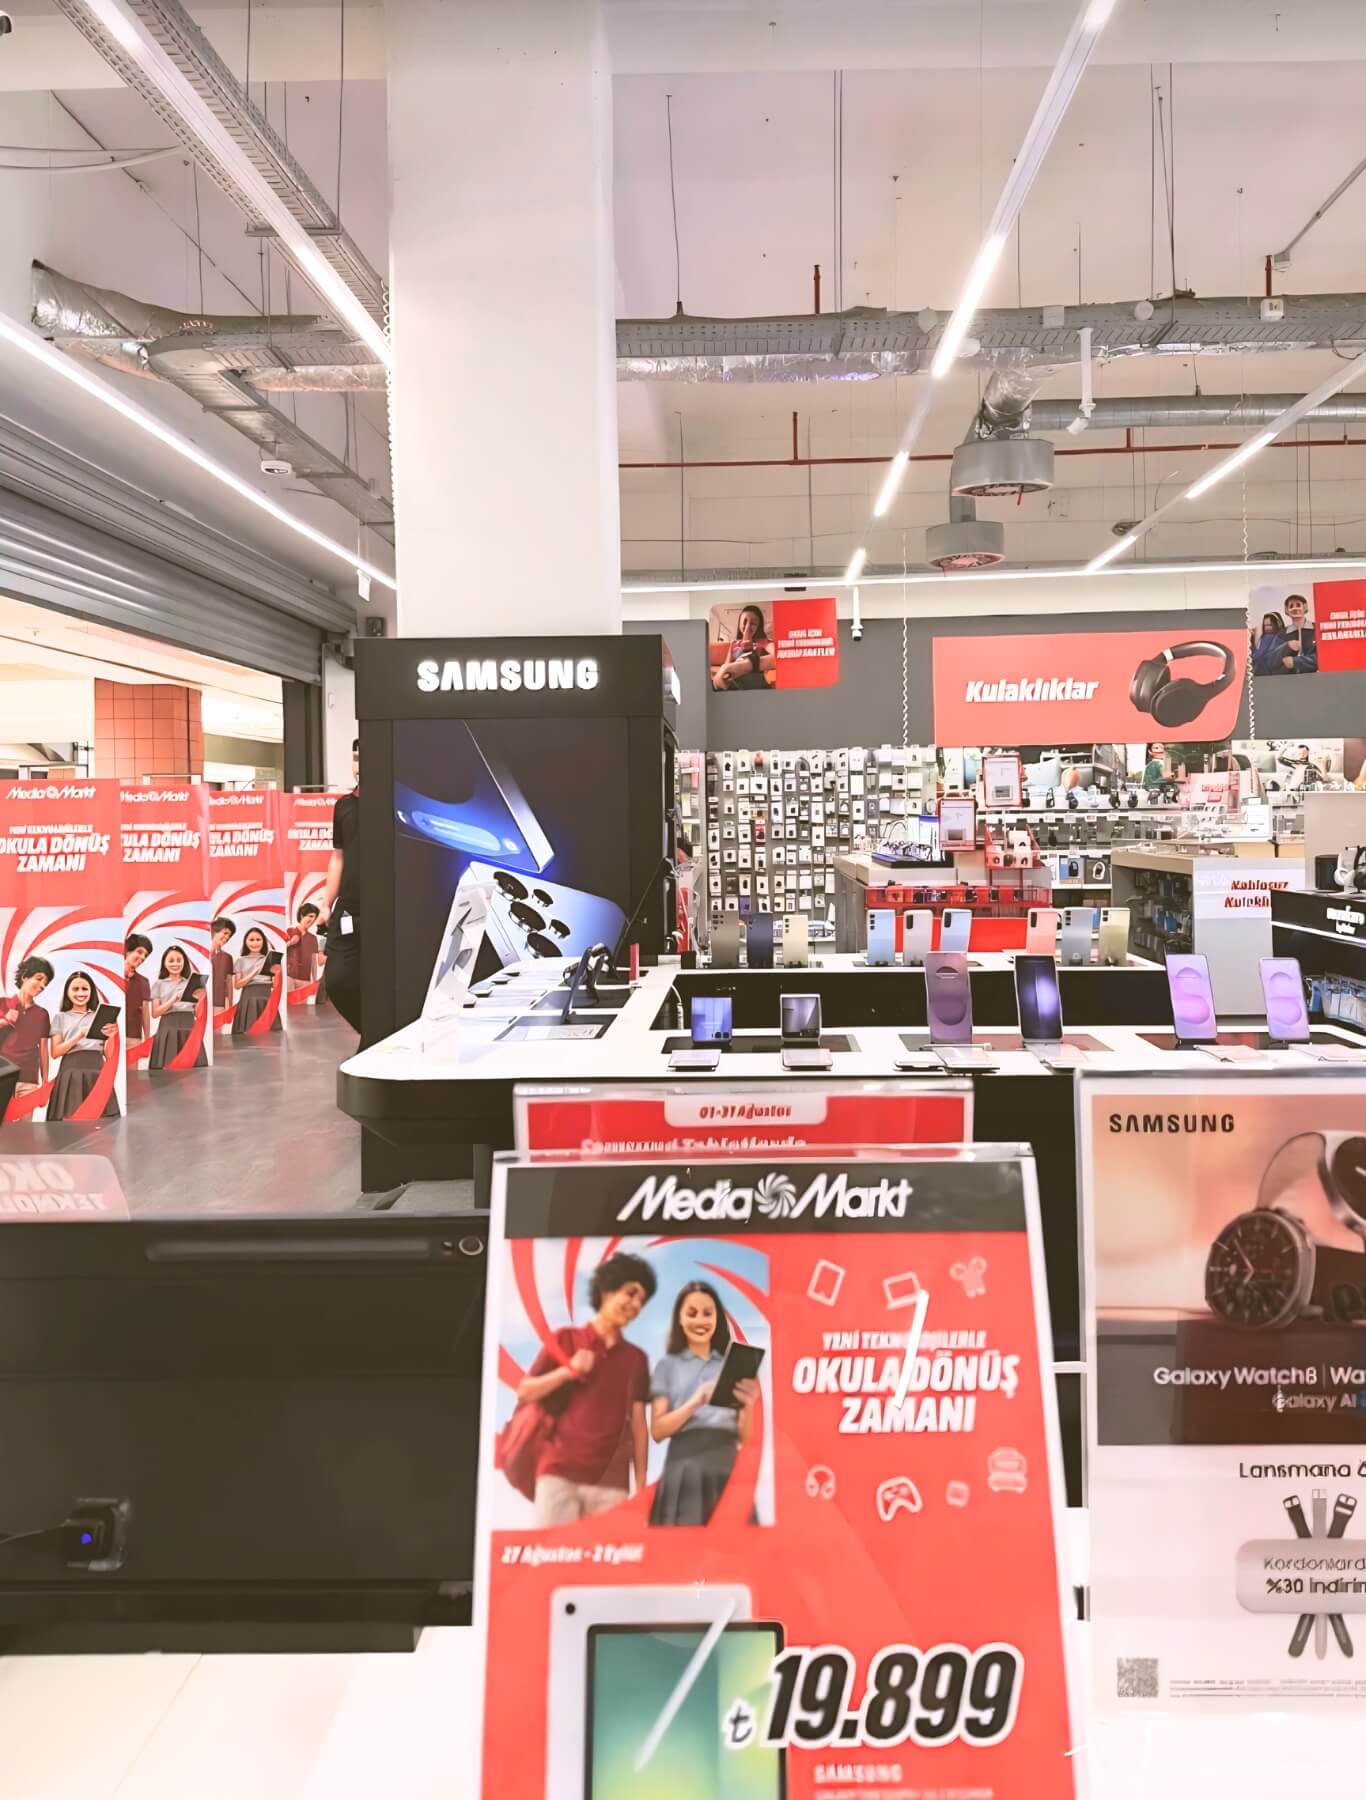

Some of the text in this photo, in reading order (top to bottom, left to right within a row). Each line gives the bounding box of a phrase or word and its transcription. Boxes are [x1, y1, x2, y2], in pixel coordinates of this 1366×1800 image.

[416, 659, 599, 693] SAMSUNG
[965, 678, 1099, 703] Kulaklıklar
[16, 854, 87, 872] ZAMANI
[123, 847, 181, 863] ZAMANI
[1109, 1113, 1235, 1133] SAMSUNG
[616, 1172, 914, 1224] Media Markt
[792, 1349, 1020, 1400] OKULA DÖNÜŞ
[1153, 1366, 1232, 1390] Galaxy
[1233, 1366, 1318, 1385] Watch8
[838, 1395, 976, 1434] ZAMANI
[1239, 1462, 1351, 1479] Lansmana
[1266, 1577, 1304, 1594] %30
[767, 1650, 1017, 1742] 19.899
